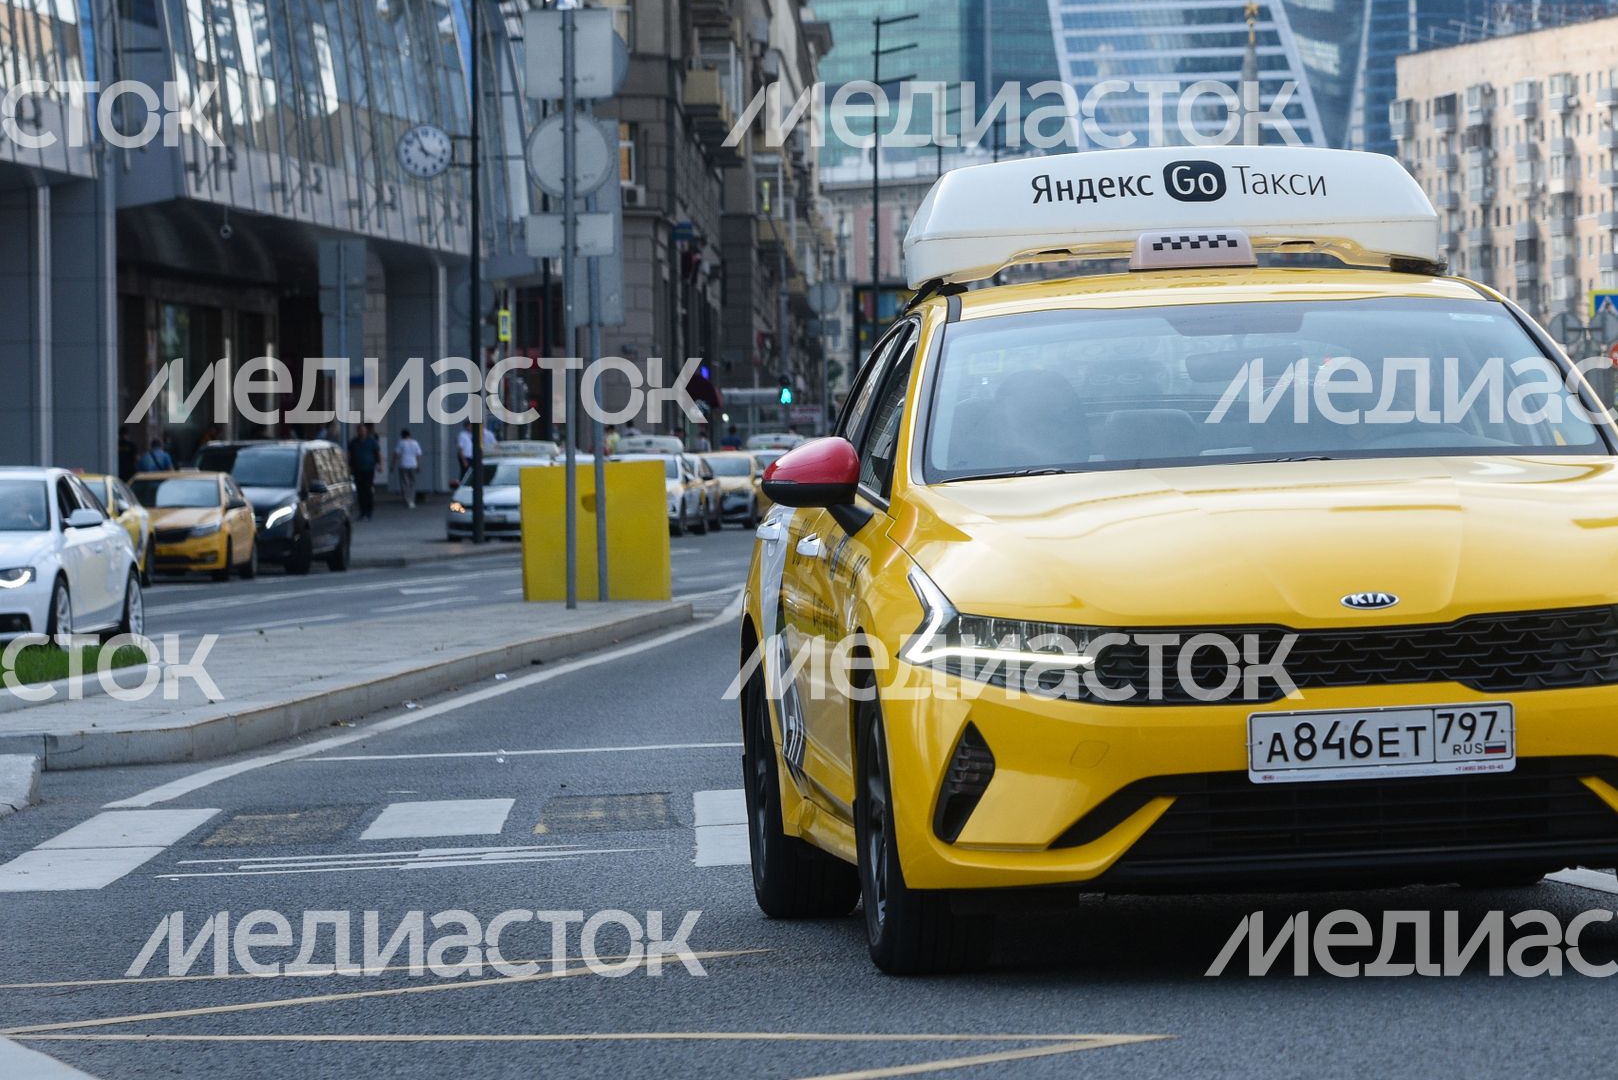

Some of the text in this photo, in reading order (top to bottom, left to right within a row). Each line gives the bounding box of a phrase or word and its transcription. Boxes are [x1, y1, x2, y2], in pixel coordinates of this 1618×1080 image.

[1031, 165, 1327, 205] Яндекс Go Такси
[1351, 592, 1391, 605] KIA
[1436, 711, 1498, 744] 797
[1453, 743, 1484, 756] RUS
